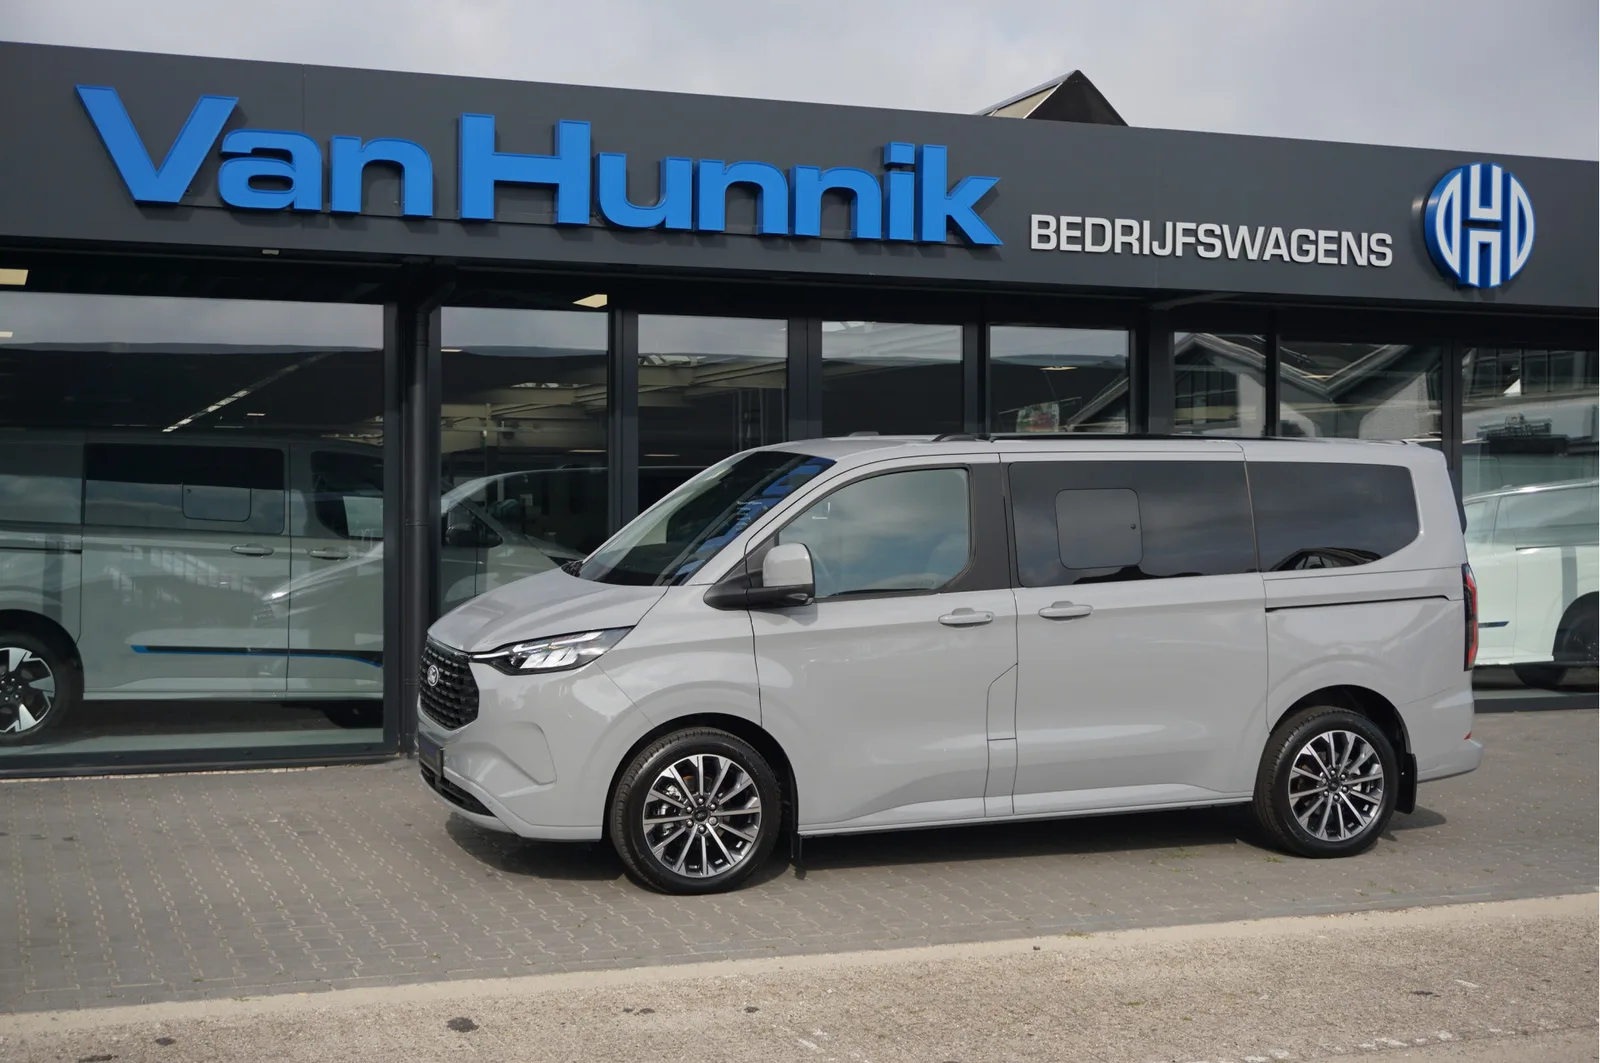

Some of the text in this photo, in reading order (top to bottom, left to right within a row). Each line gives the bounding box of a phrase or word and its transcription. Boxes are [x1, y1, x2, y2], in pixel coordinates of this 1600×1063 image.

[74, 84, 1004, 248] Van Hunnik
[1030, 213, 1394, 269] BEDRIJFSWAGENS
